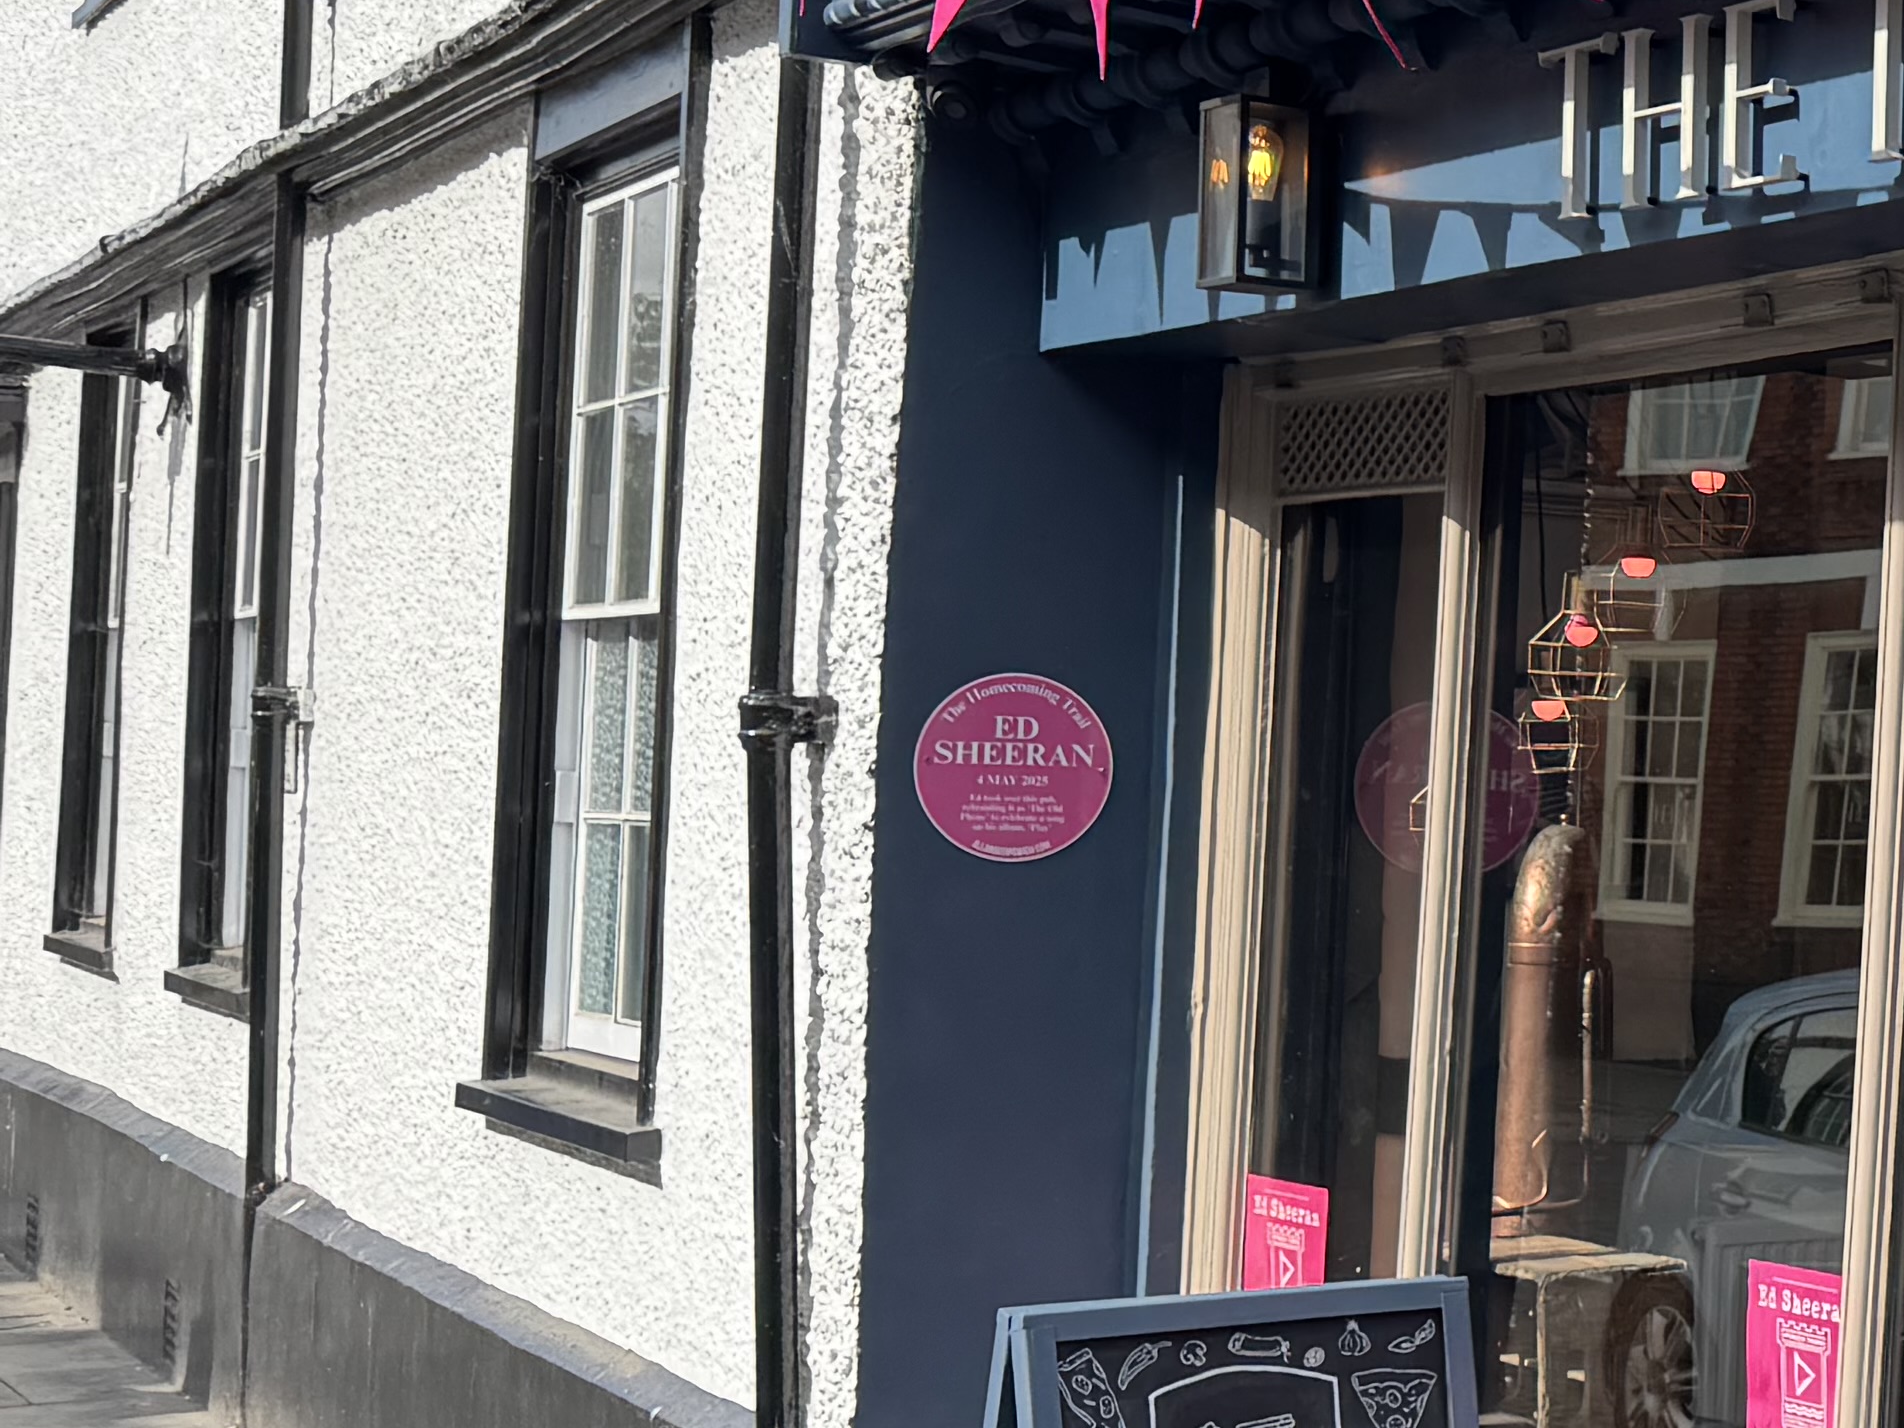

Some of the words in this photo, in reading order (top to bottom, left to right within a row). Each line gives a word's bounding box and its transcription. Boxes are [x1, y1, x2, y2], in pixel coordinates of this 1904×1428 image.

[941, 700, 967, 723] The
[965, 682, 1061, 705] Homecoming
[1062, 697, 1092, 729] Trail
[993, 715, 1040, 741] ED
[933, 740, 1095, 768] SHEERAN
[976, 774, 984, 785] 4
[986, 775, 1017, 786] MAY
[1021, 775, 1050, 787] 2025
[1253, 1194, 1268, 1217] Ed
[1269, 1197, 1321, 1228] Sheeran
[1757, 1283, 1778, 1310] Ed
[1781, 1290, 1842, 1323] Sheera
